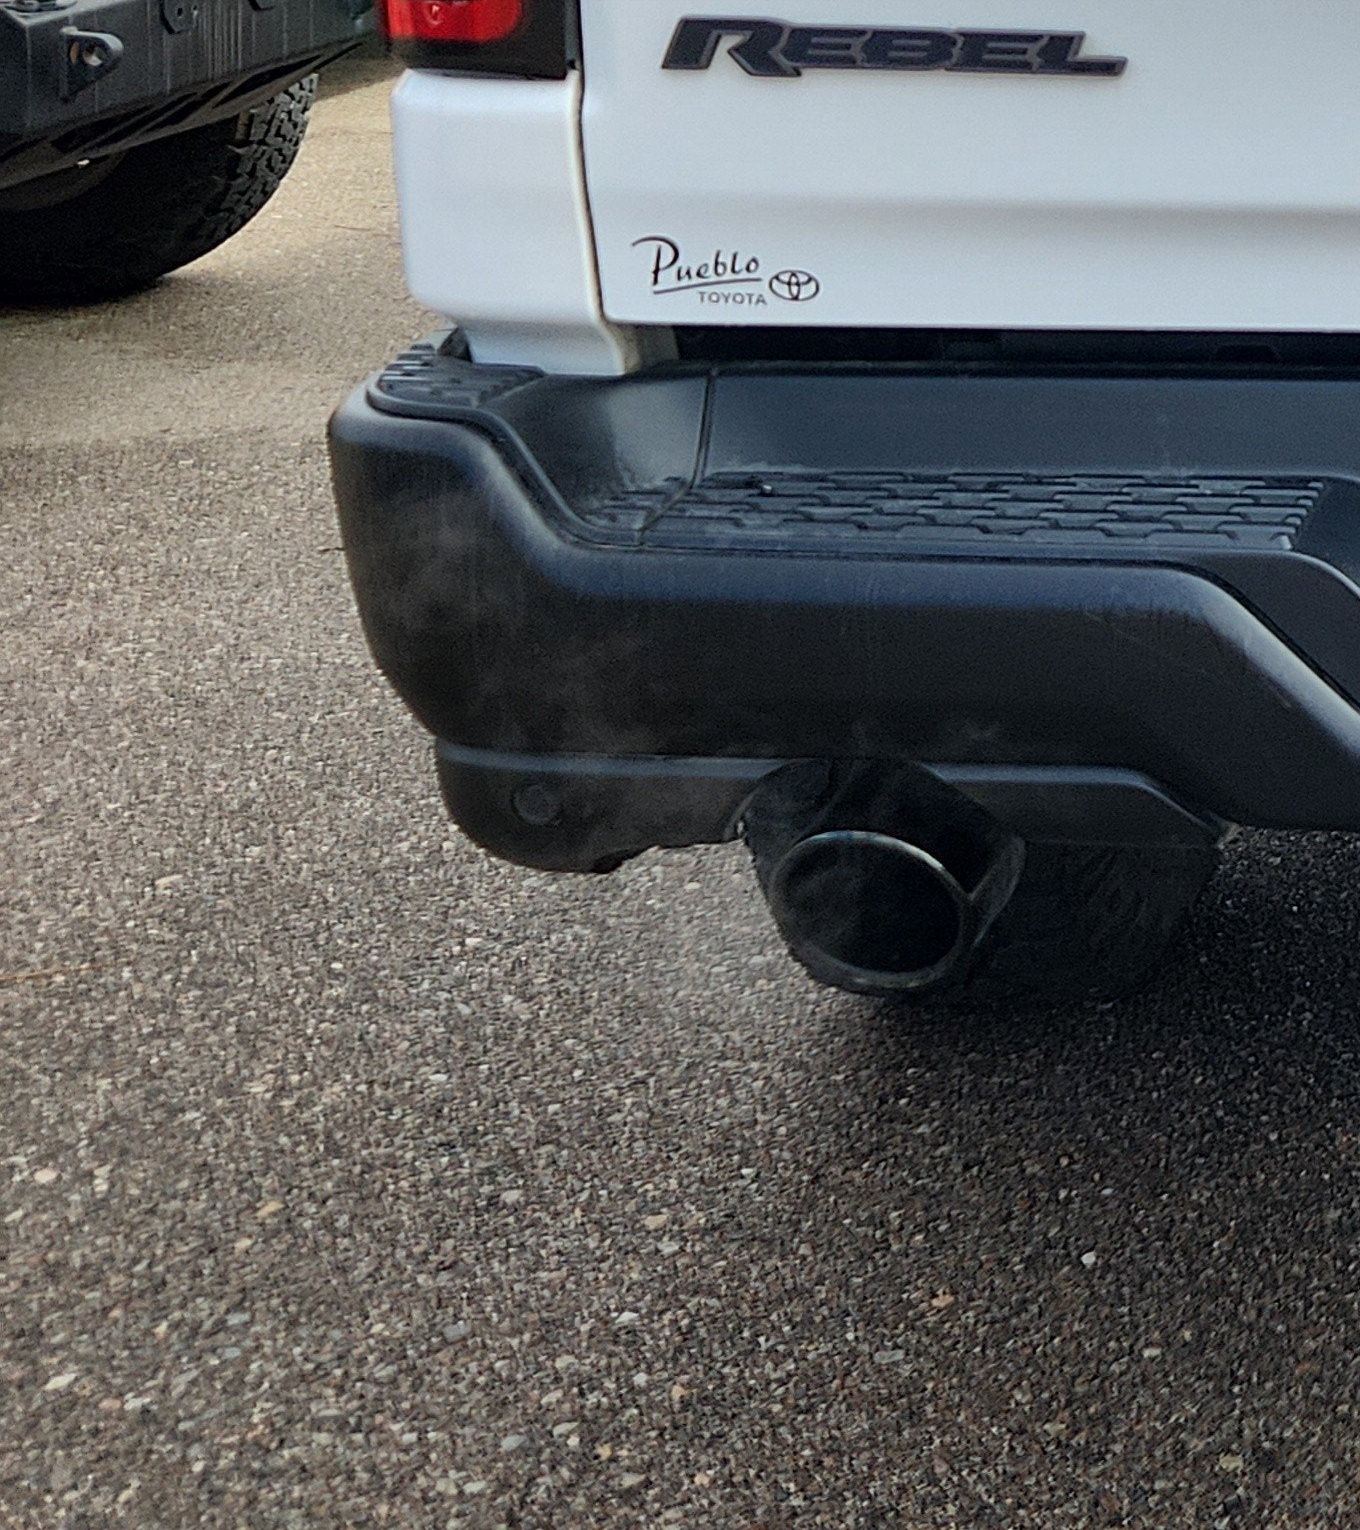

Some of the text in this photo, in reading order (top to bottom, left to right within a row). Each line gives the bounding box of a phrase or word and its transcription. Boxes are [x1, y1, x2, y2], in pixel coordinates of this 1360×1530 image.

[661, 16, 1129, 77] REBEL
[632, 236, 760, 286] Pueblo
[699, 291, 767, 306] TOYOTA
